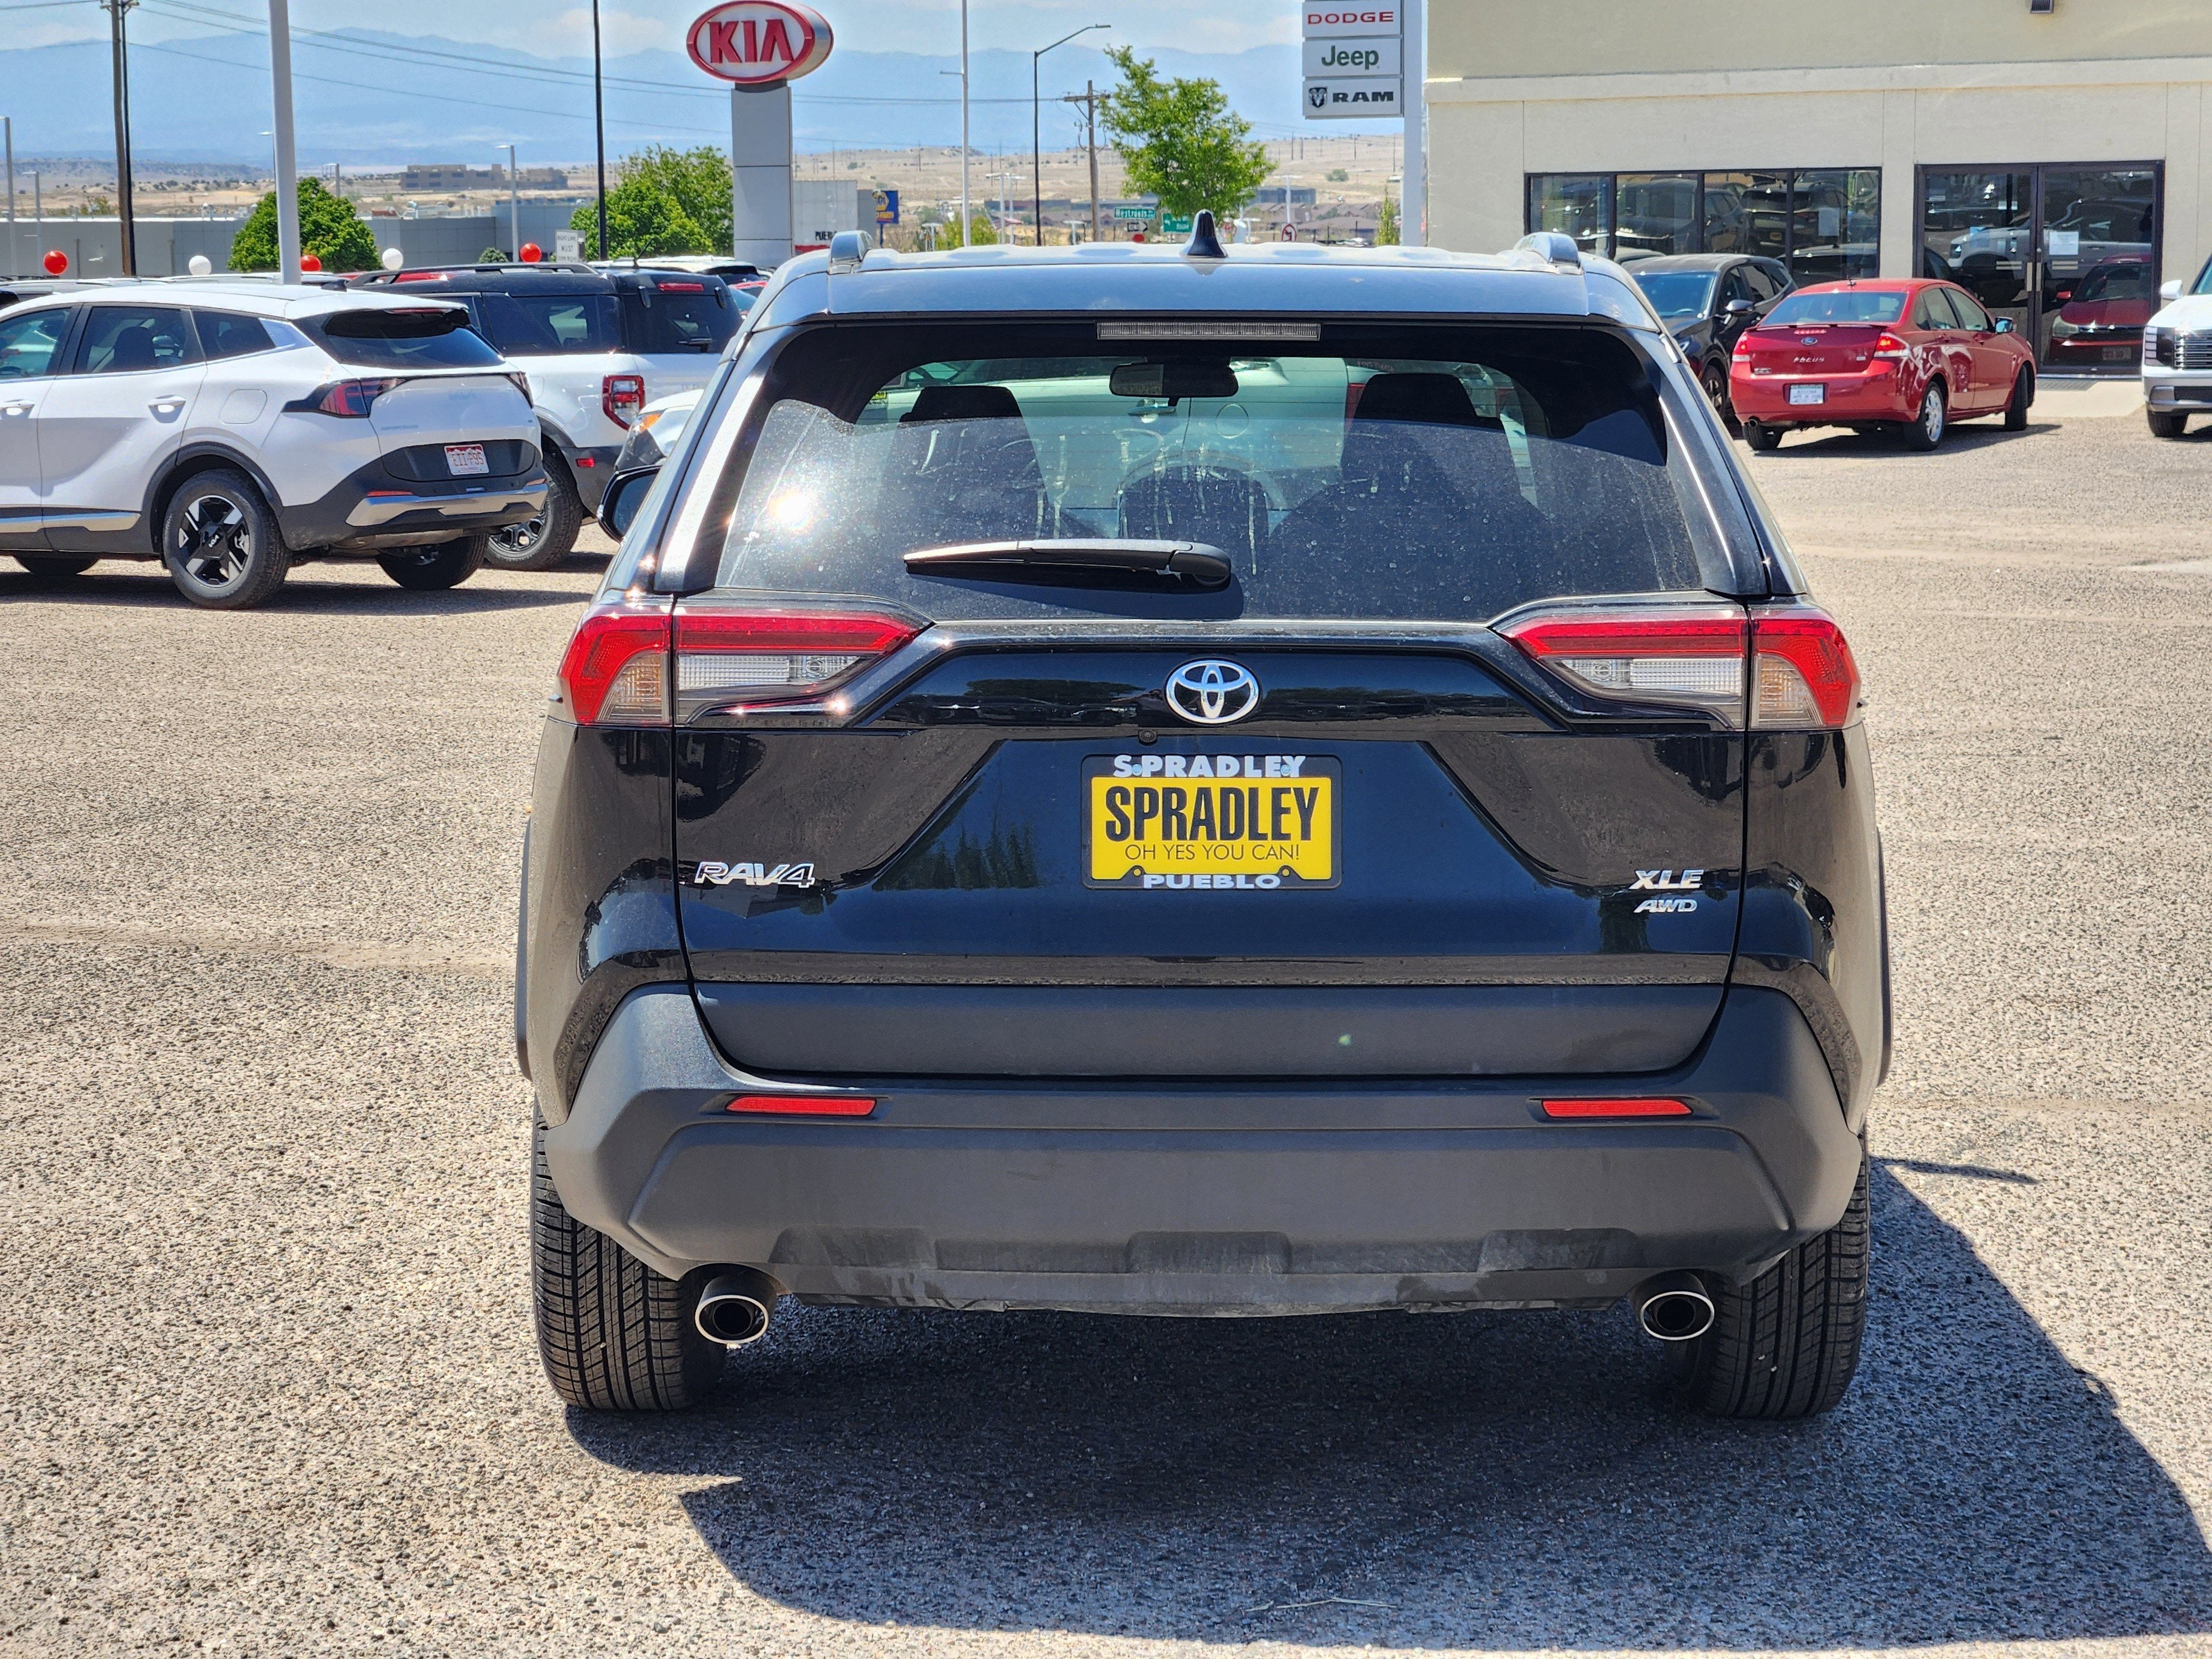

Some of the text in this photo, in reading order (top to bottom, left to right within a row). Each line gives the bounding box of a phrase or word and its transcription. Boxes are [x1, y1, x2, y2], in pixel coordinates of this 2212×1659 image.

[1307, 12, 1394, 24] DODGE
[707, 19, 794, 64] KIA
[1321, 45, 1379, 70] Jeep
[1333, 91, 1394, 103] RAM
[1113, 755, 1306, 778] SPRADLEY
[1105, 785, 1320, 842] SPRADLEY
[1125, 844, 1300, 860] OH YES YOU CAN!
[694, 862, 815, 888] RAV4
[1143, 874, 1281, 889] PUEBLO
[1629, 869, 1704, 889] XLE
[1633, 899, 1698, 913] AWD
